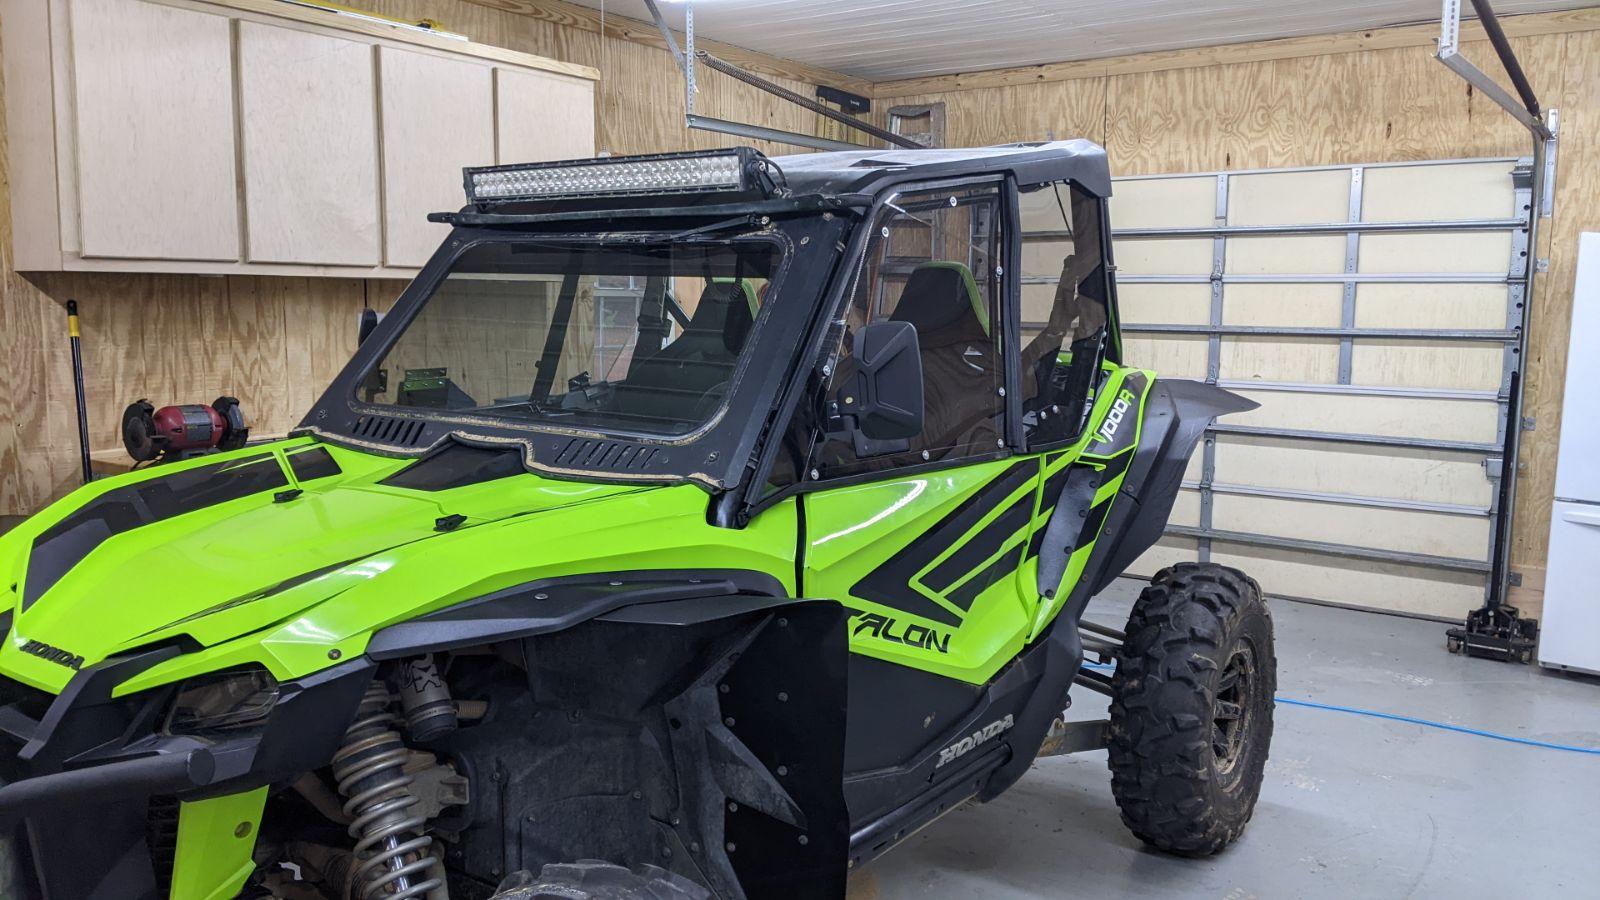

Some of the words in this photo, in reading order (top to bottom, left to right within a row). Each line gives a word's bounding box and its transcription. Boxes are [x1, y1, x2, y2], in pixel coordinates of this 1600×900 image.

[1094, 389, 1135, 443] 1000R
[19, 639, 85, 671] HONDA
[935, 713, 1014, 769] HONDA
